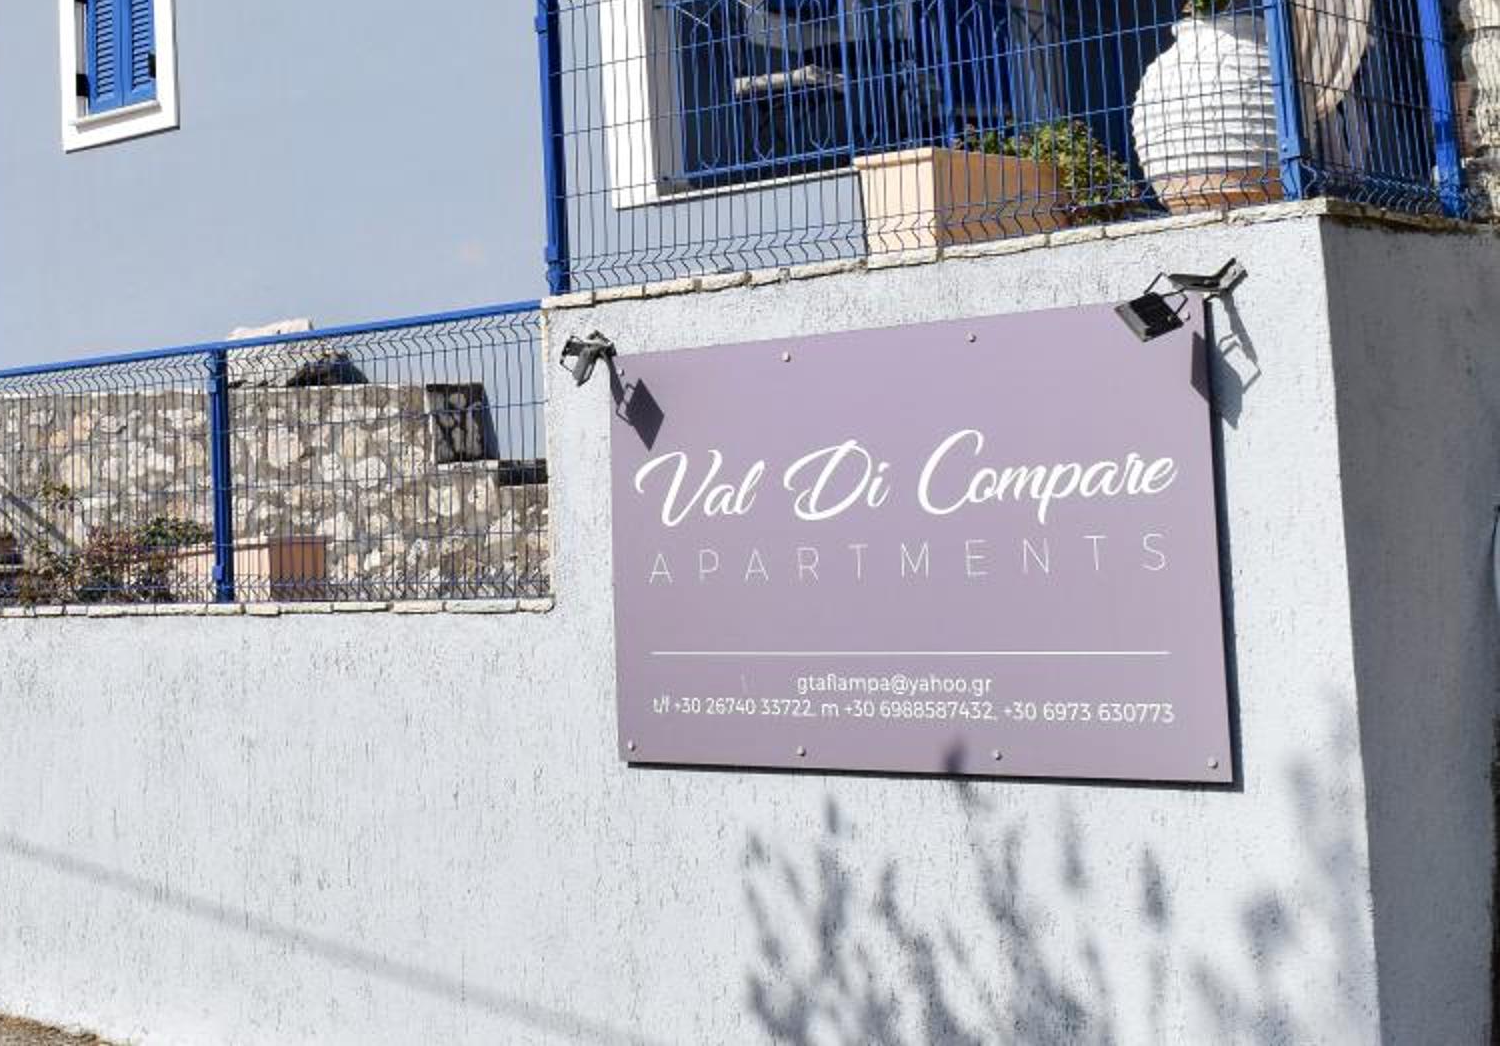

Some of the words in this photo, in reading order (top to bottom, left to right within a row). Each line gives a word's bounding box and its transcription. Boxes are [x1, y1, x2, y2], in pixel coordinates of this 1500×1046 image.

[635, 449, 765, 527] Val
[783, 439, 891, 521] Di
[918, 429, 1177, 524] Compare
[649, 532, 1168, 584] APARTMENTS
[675, 697, 700, 714] +30
[706, 697, 755, 715] 26740
[822, 703, 839, 716] m
[844, 699, 875, 717] +30
[1004, 703, 1037, 722] +30
[1043, 703, 1091, 722] 6973
[1098, 704, 1175, 723] 630773
